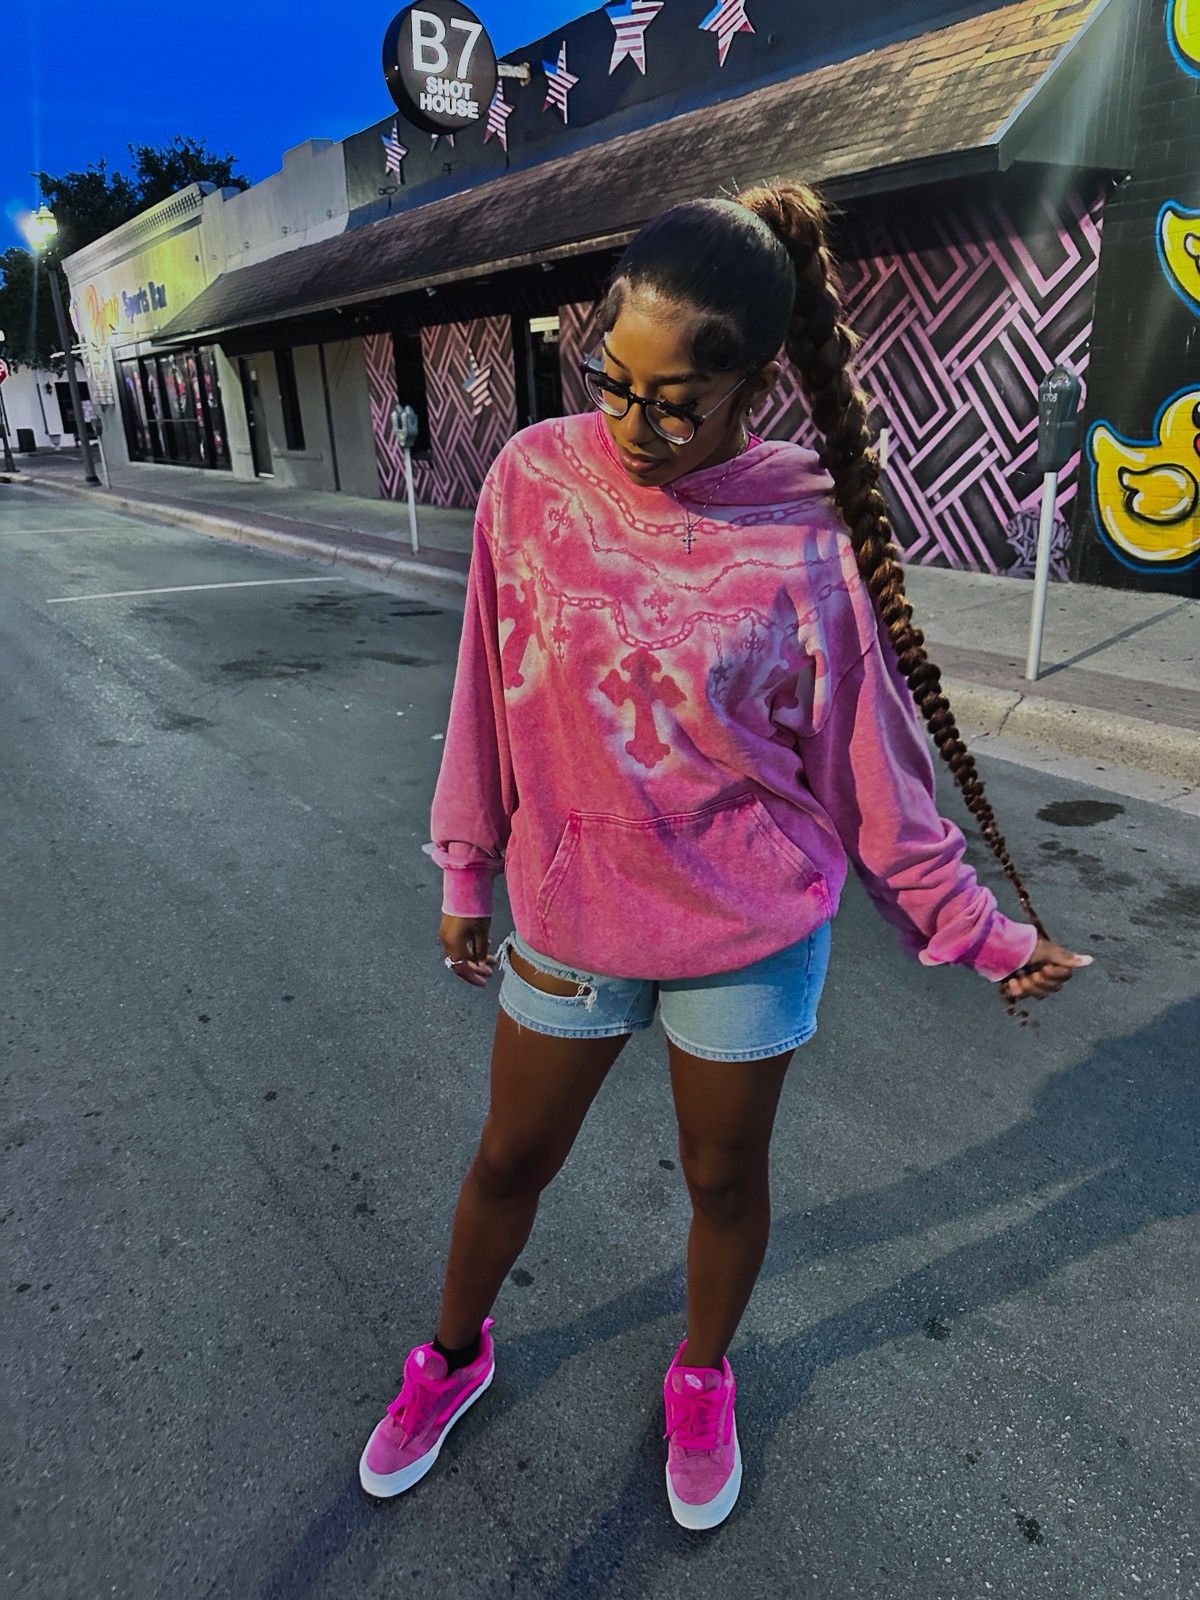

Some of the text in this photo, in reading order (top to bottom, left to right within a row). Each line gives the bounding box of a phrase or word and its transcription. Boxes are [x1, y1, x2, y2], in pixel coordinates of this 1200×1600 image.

[411, 9, 482, 80] B7
[426, 76, 473, 100] SHOT
[420, 93, 479, 119] HOUSE
